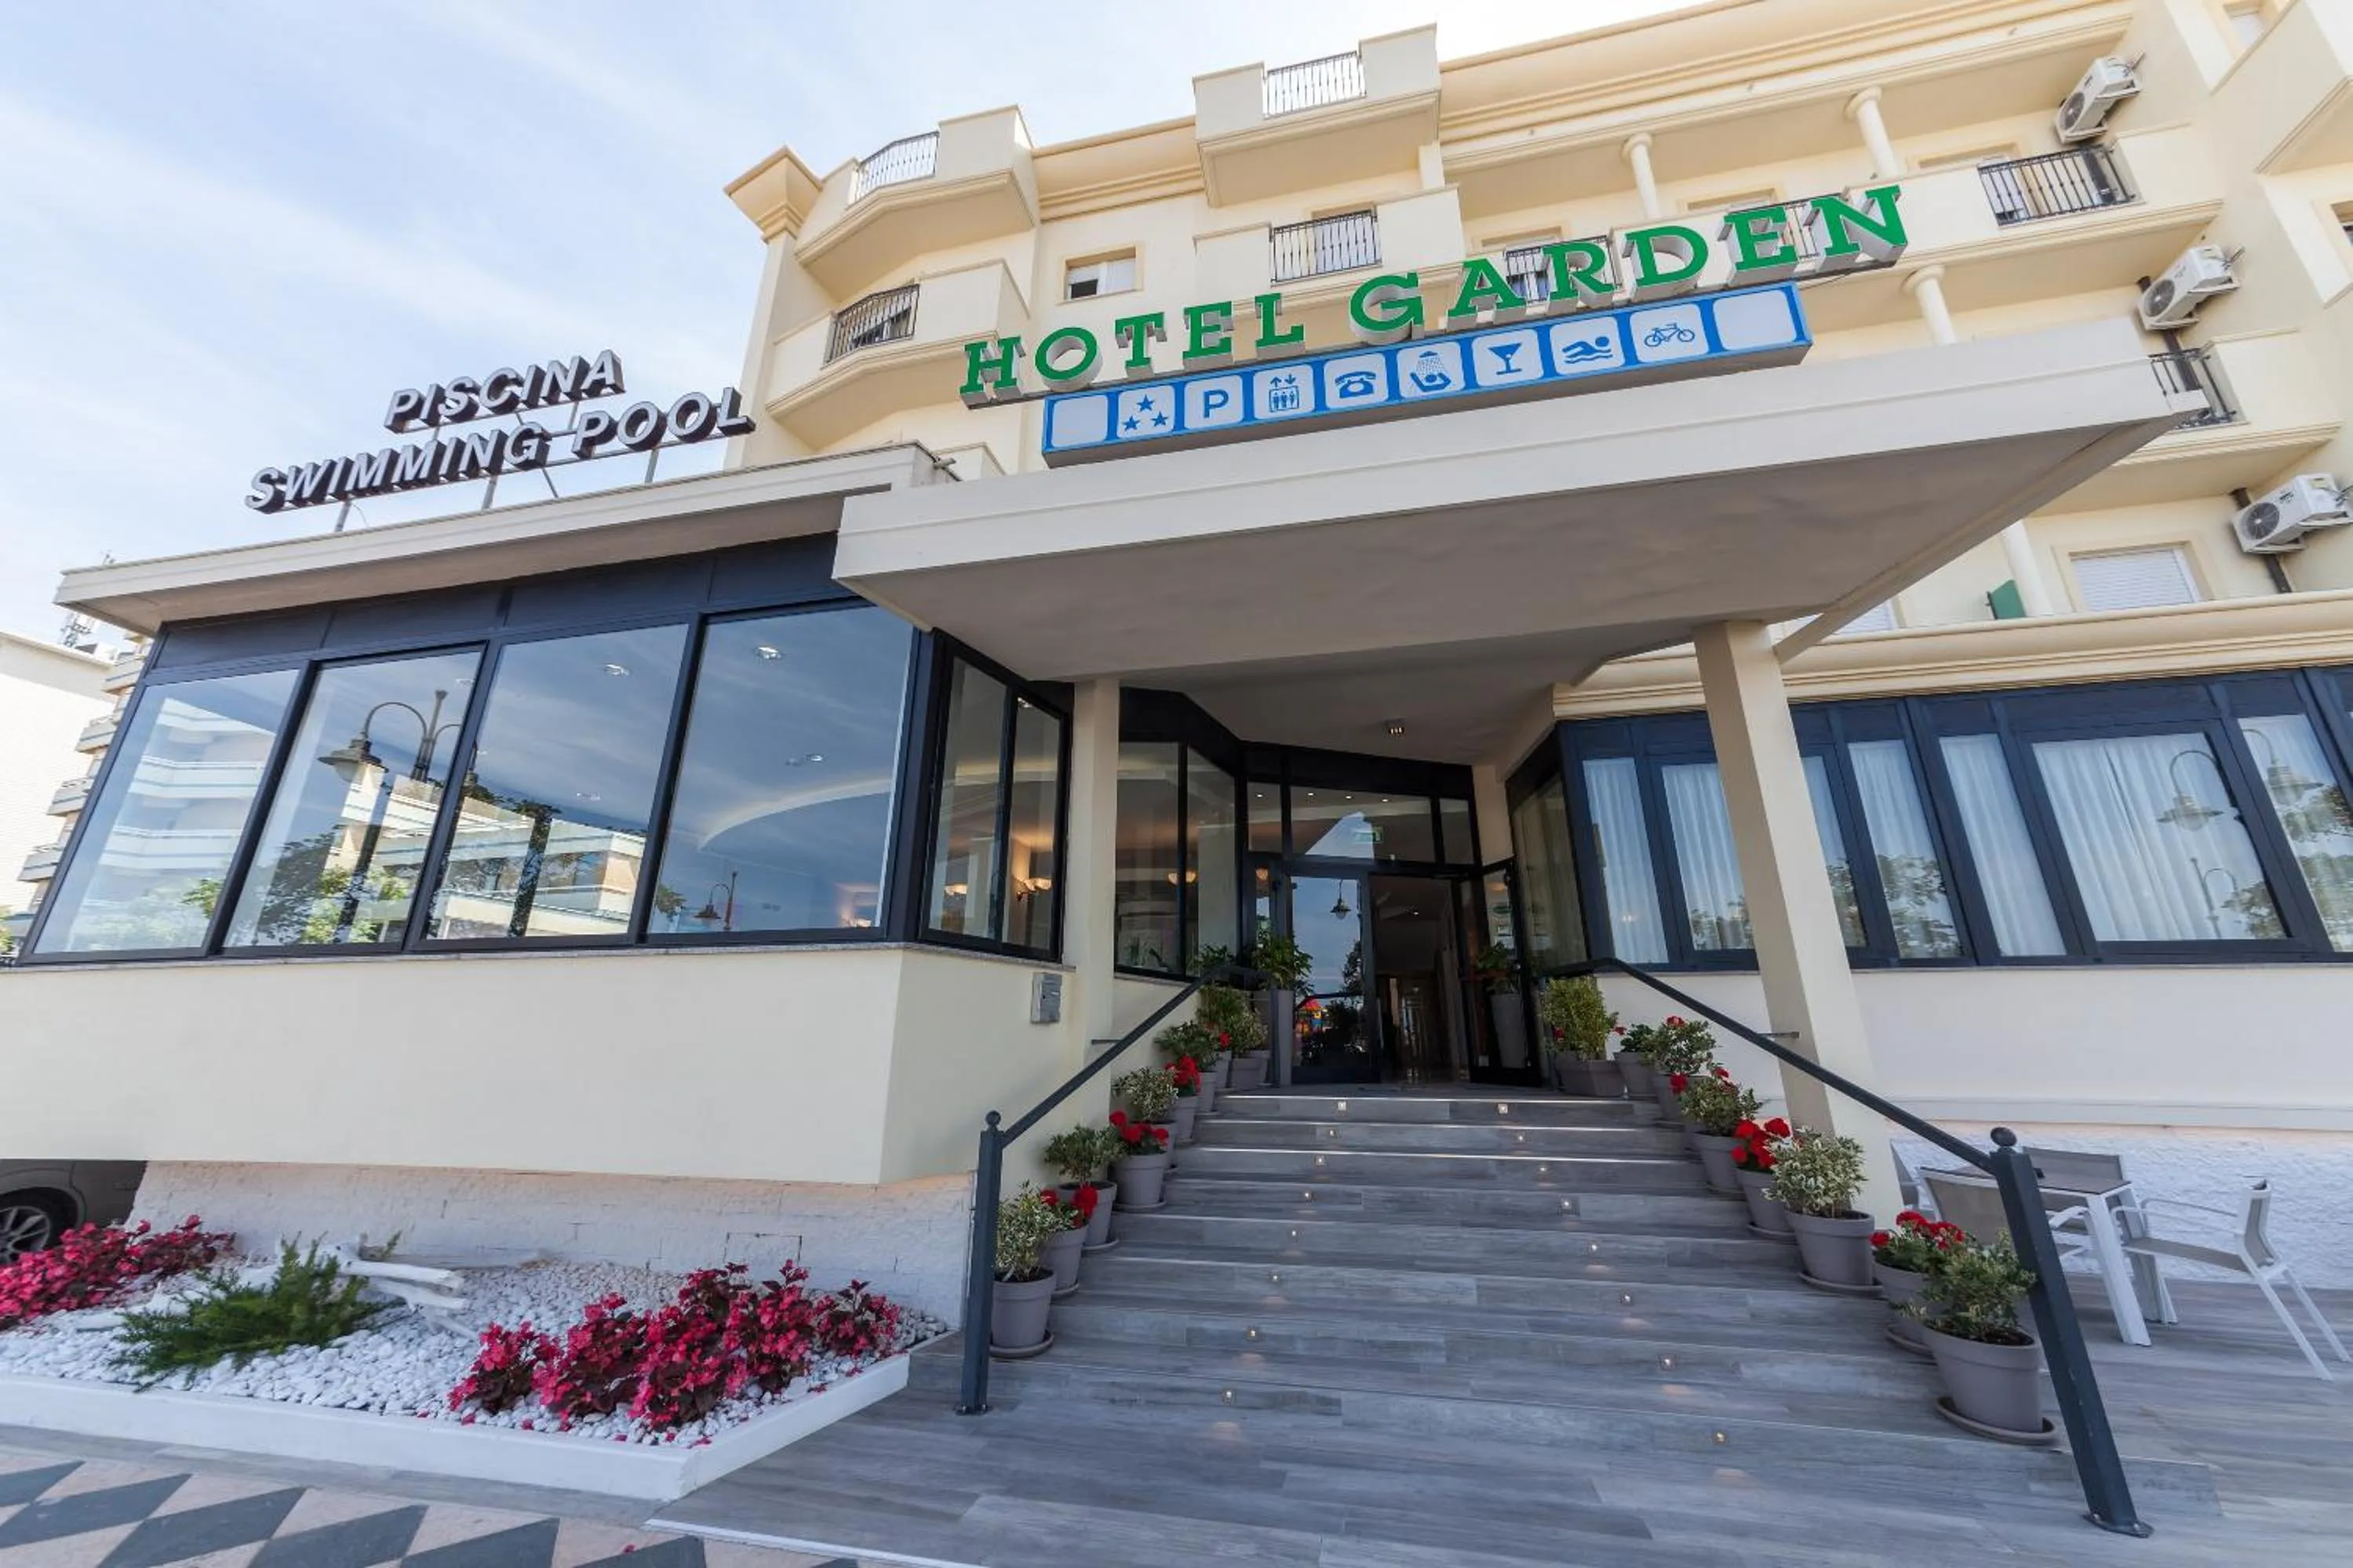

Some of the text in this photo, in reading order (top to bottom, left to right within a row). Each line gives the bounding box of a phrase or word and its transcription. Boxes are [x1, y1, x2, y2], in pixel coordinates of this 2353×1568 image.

[959, 184, 1907, 395] HOTEL GARDEN
[382, 349, 625, 434] PISCINA
[1203, 389, 1229, 418] P
[245, 387, 756, 513] SWIMMING POOL
